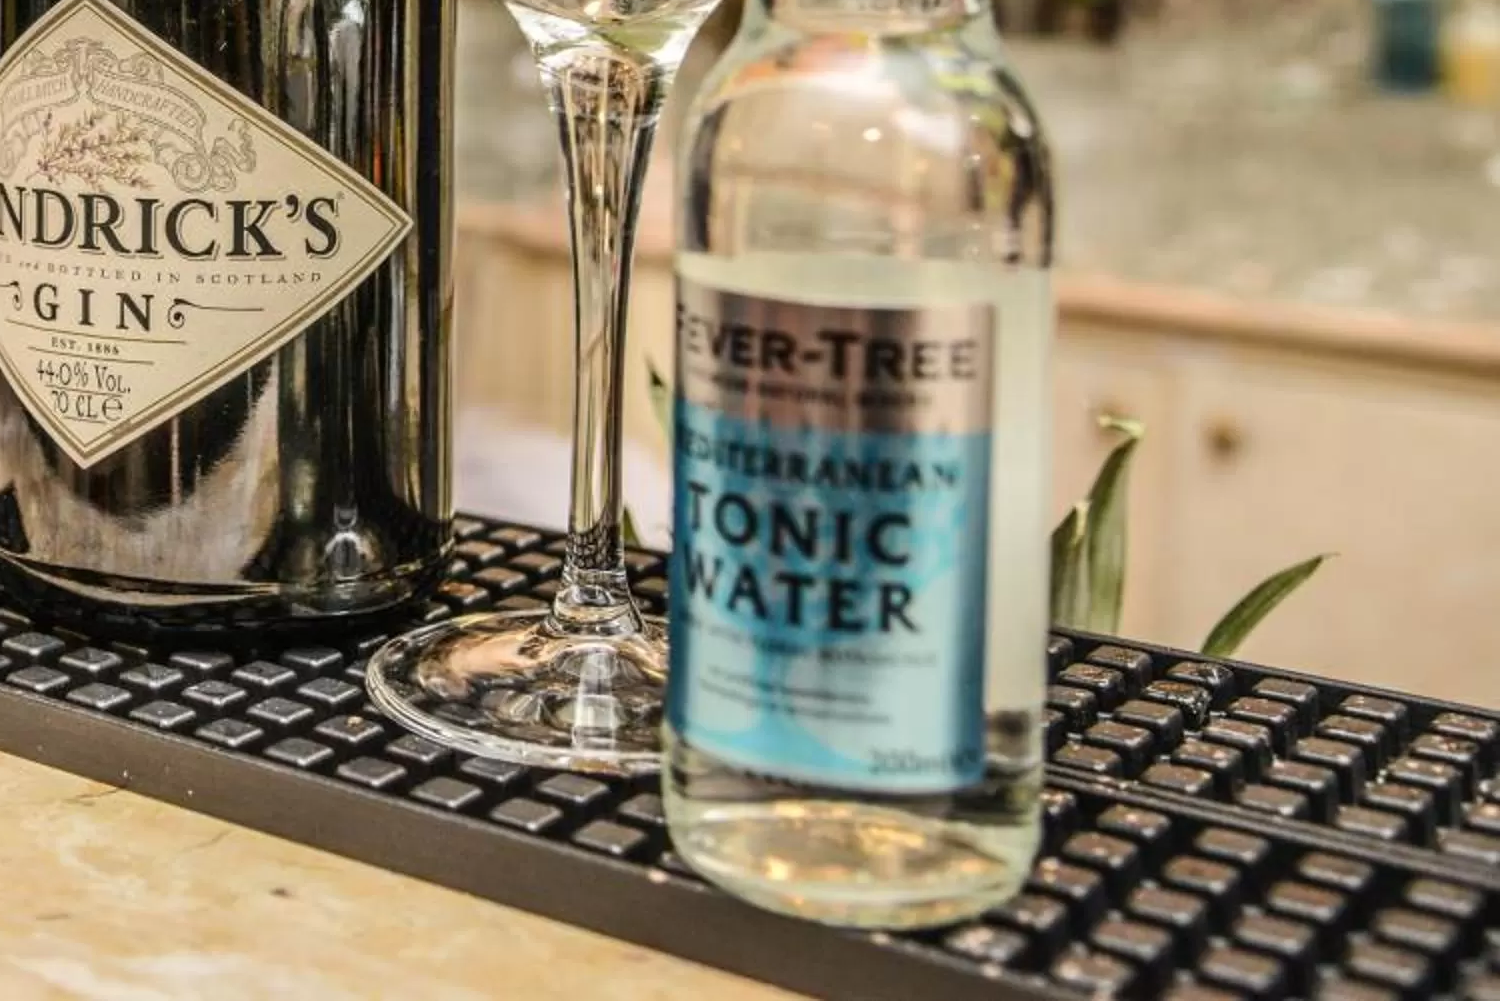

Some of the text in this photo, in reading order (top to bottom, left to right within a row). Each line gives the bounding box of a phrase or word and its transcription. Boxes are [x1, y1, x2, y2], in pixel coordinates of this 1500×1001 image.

[98, 76, 198, 129] HANDCRAFTED
[47, 261, 142, 281] BOTTLED
[156, 272, 181, 285] IN
[195, 271, 323, 286] SCOTLAND
[33, 282, 156, 332] GIN
[36, 358, 90, 389] 44.0%
[51, 390, 70, 414] 70
[684, 423, 960, 493] EDITERRANEAN
[687, 480, 913, 567] TONIC
[682, 543, 921, 635] WATER
